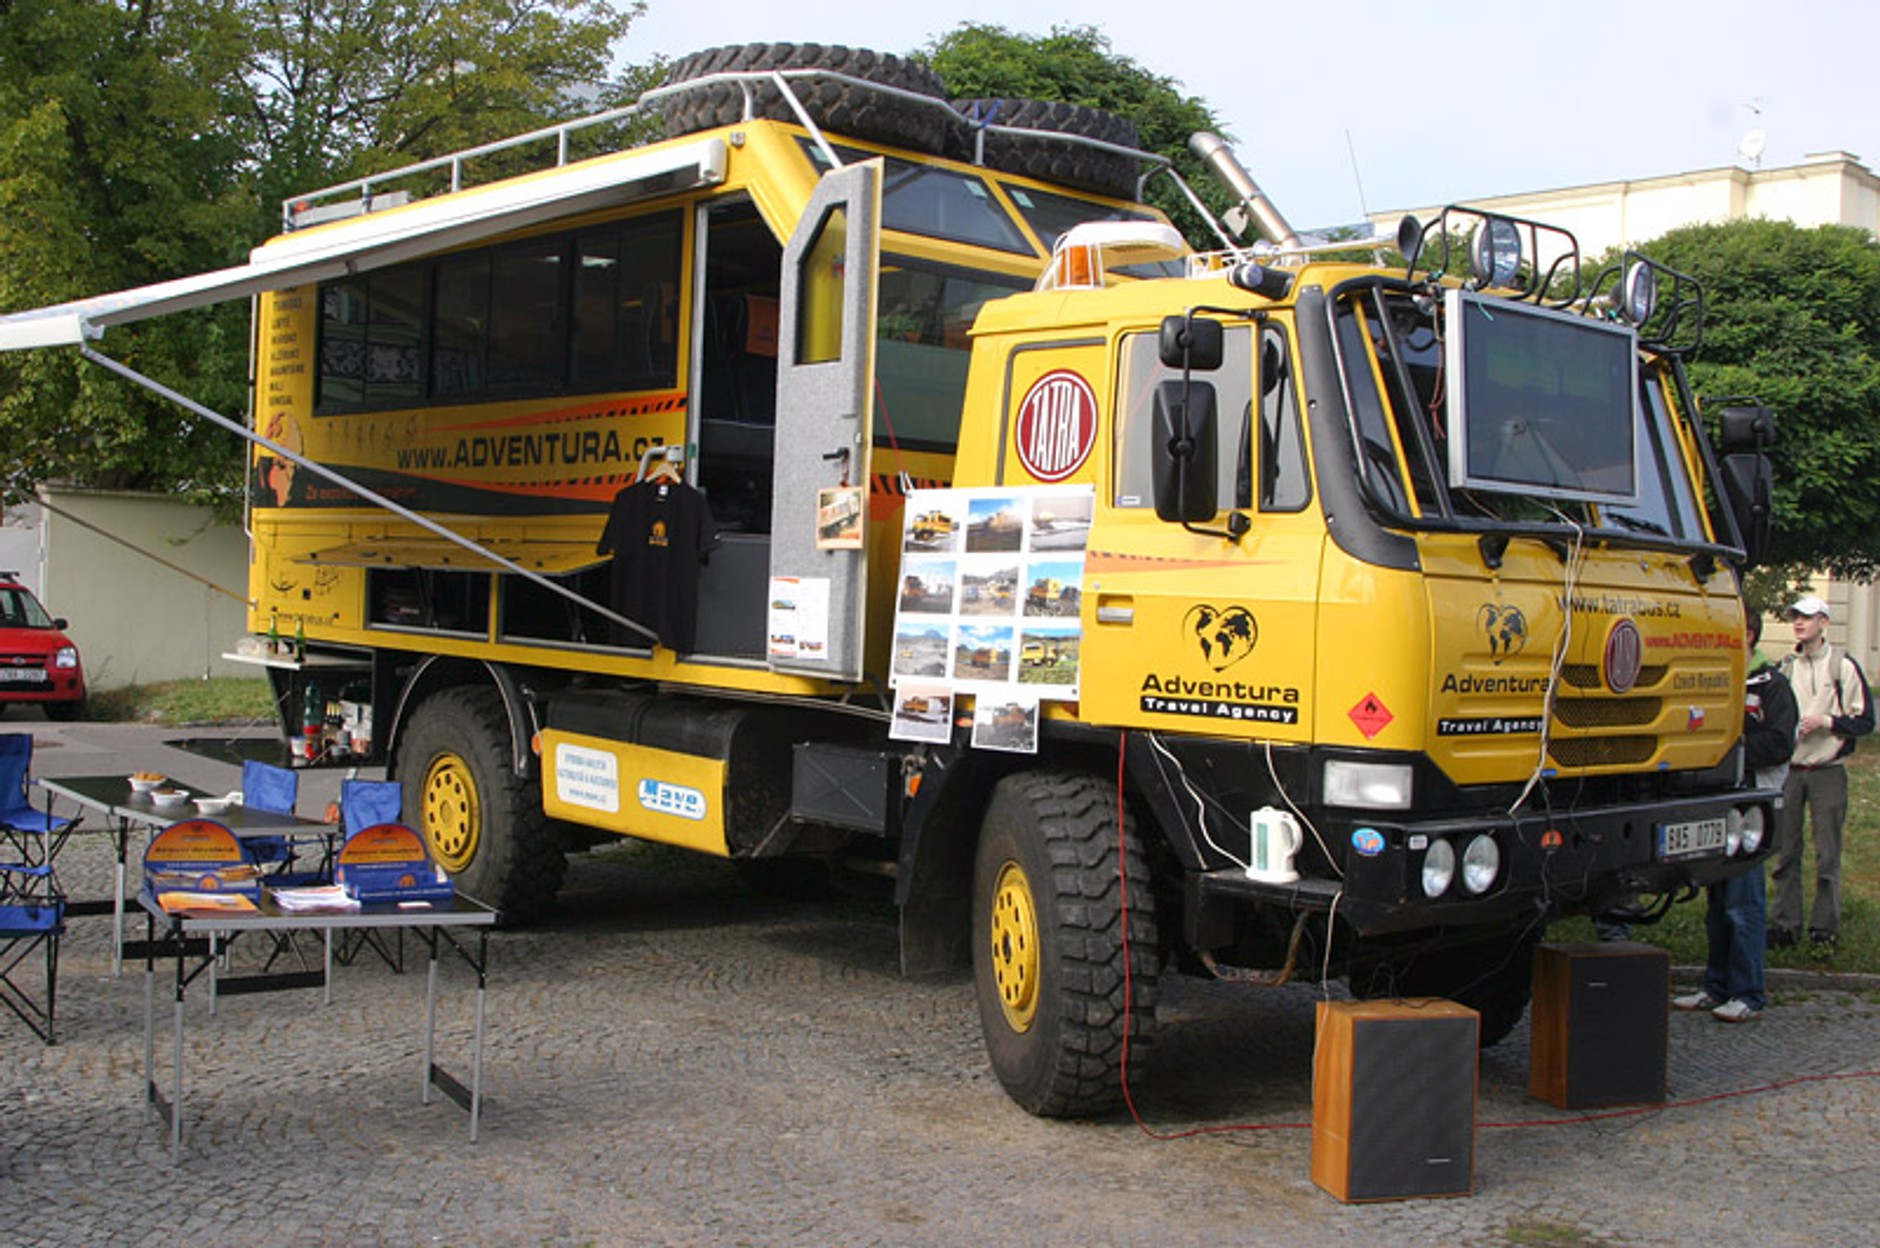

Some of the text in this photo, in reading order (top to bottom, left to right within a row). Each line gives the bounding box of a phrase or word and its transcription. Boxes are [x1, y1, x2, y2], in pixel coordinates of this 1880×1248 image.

[1029, 381, 1080, 471] TATRA
[397, 430, 664, 468] www.ADVENTURA.cz
[1141, 674, 1299, 703] Adventura
[1441, 673, 1550, 693] Adventura
[1144, 698, 1293, 723] Travel Agency
[1441, 720, 1544, 733] Travel Agency
[1697, 822, 1722, 847] 0779
